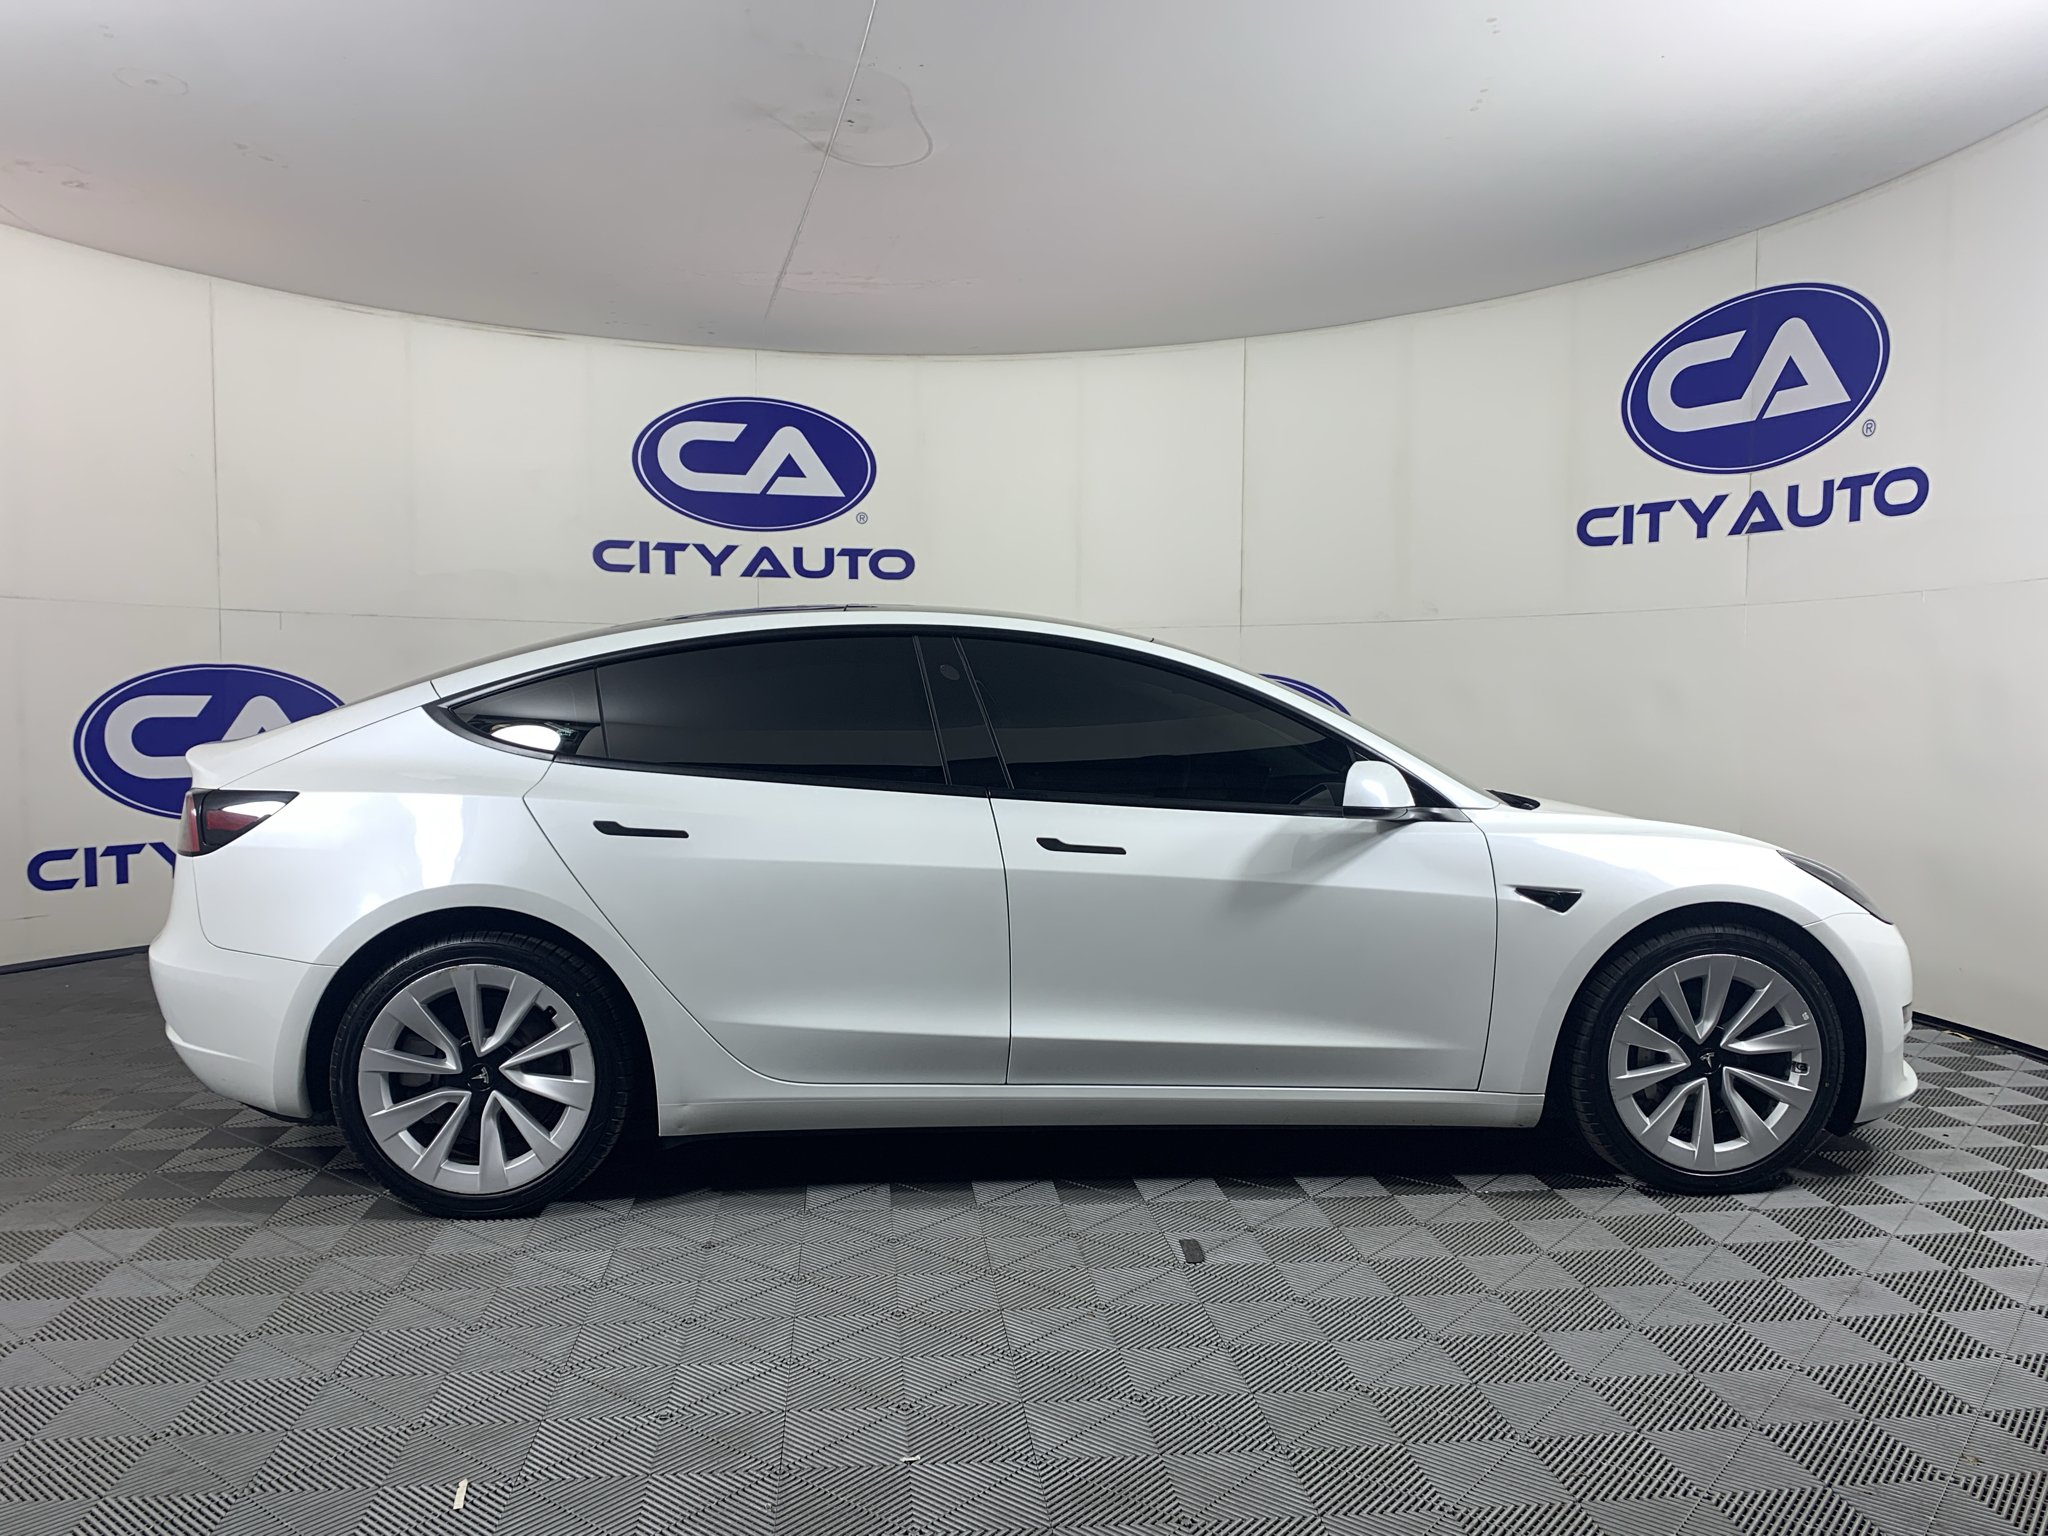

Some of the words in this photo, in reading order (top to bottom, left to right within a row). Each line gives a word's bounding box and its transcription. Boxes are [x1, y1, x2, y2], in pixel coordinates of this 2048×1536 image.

[1647, 316, 1851, 433] CA
[657, 420, 846, 498] CA
[1576, 491, 1733, 547] CITY
[1726, 465, 1930, 536] AUTO
[592, 539, 740, 577] CITY
[739, 545, 916, 580] AUTO
